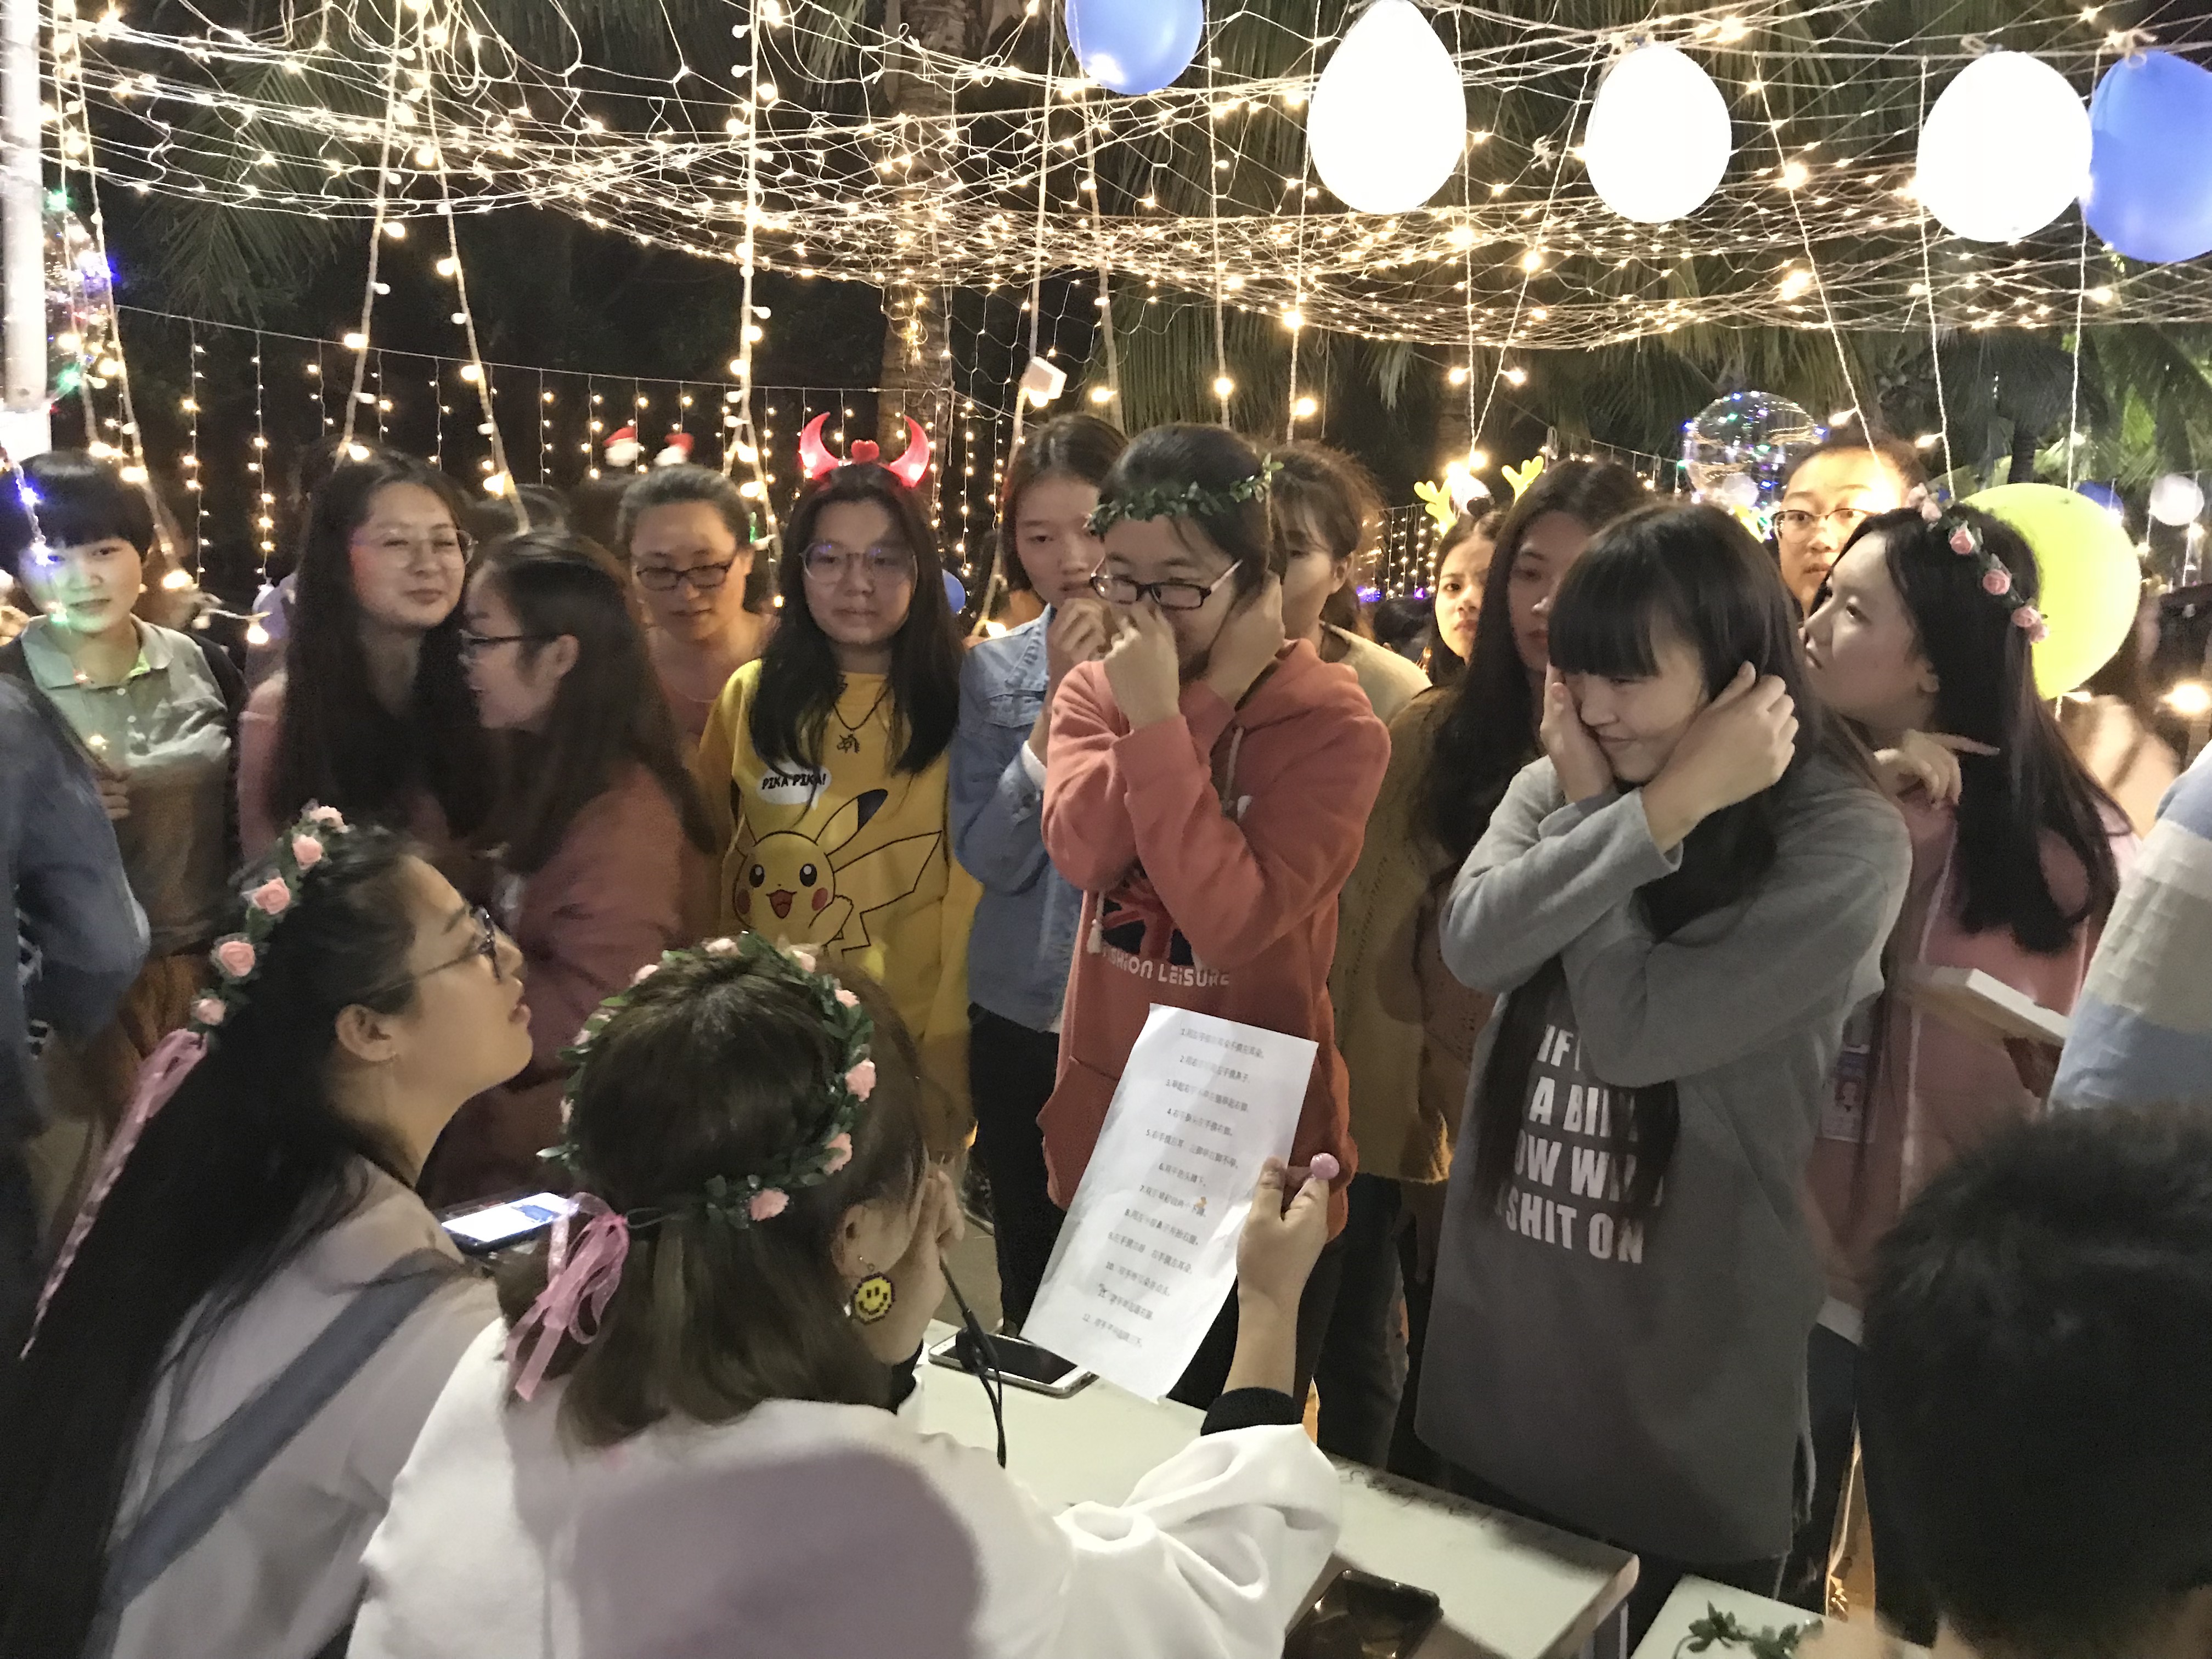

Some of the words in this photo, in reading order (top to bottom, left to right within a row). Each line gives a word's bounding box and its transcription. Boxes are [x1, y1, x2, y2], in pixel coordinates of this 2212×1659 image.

[762, 776, 789, 790] PIKA
[1536, 1024, 1574, 1066] IF
[1528, 1076, 1555, 1125] A
[1505, 1185, 1577, 1250] SHIT
[1588, 1212, 1644, 1265] ON
